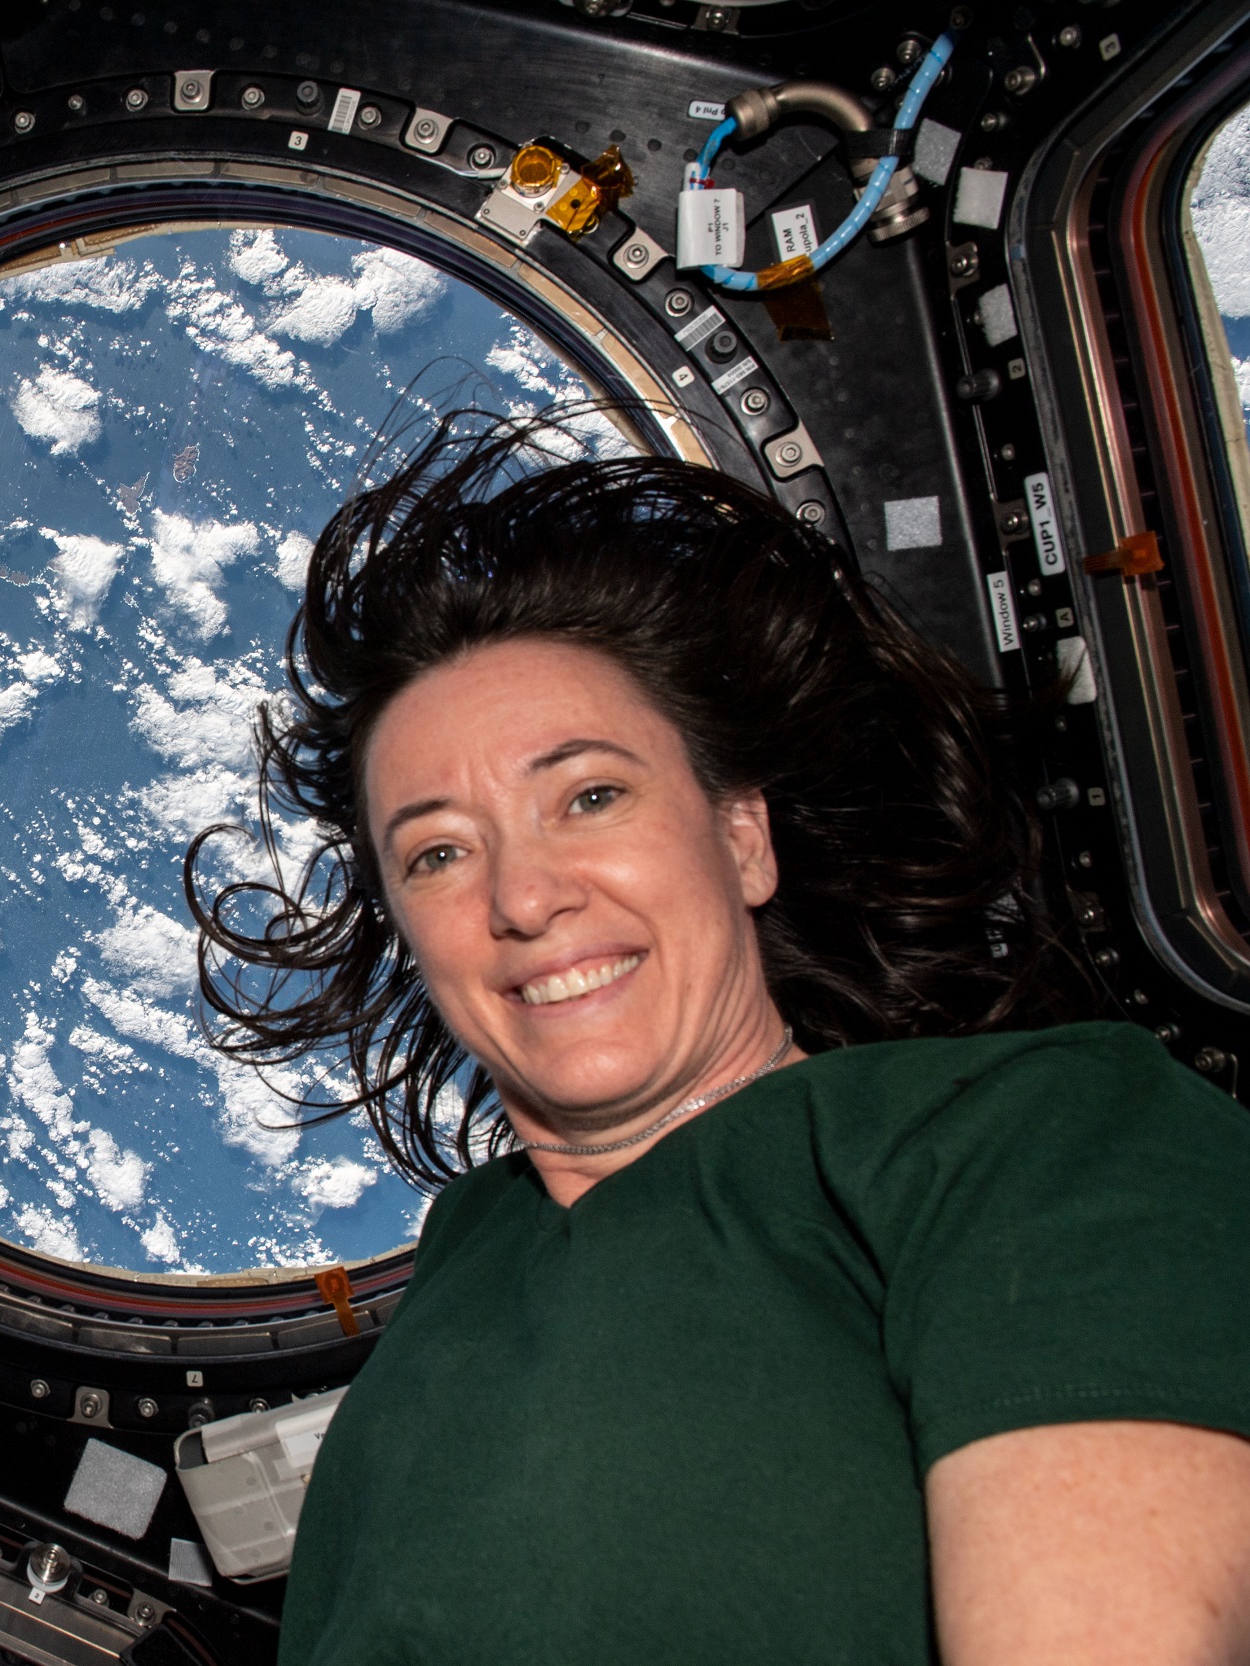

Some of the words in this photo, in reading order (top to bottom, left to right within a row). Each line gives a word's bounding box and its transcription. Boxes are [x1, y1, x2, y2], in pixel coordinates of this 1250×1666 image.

[294, 136, 302, 146] 3
[708, 222, 714, 233] P1
[714, 205, 722, 244] WINDOW
[722, 222, 729, 232] J1
[795, 212, 813, 255] upola_2
[782, 227, 796, 253] RAM
[715, 245, 722, 256] TO
[679, 373, 688, 381] 4
[1031, 482, 1058, 566] CUP1_W5
[993, 579, 1005, 589] 5
[999, 592, 1014, 646] Window
[1060, 611, 1070, 622] A
[191, 1374, 198, 1383] 7
